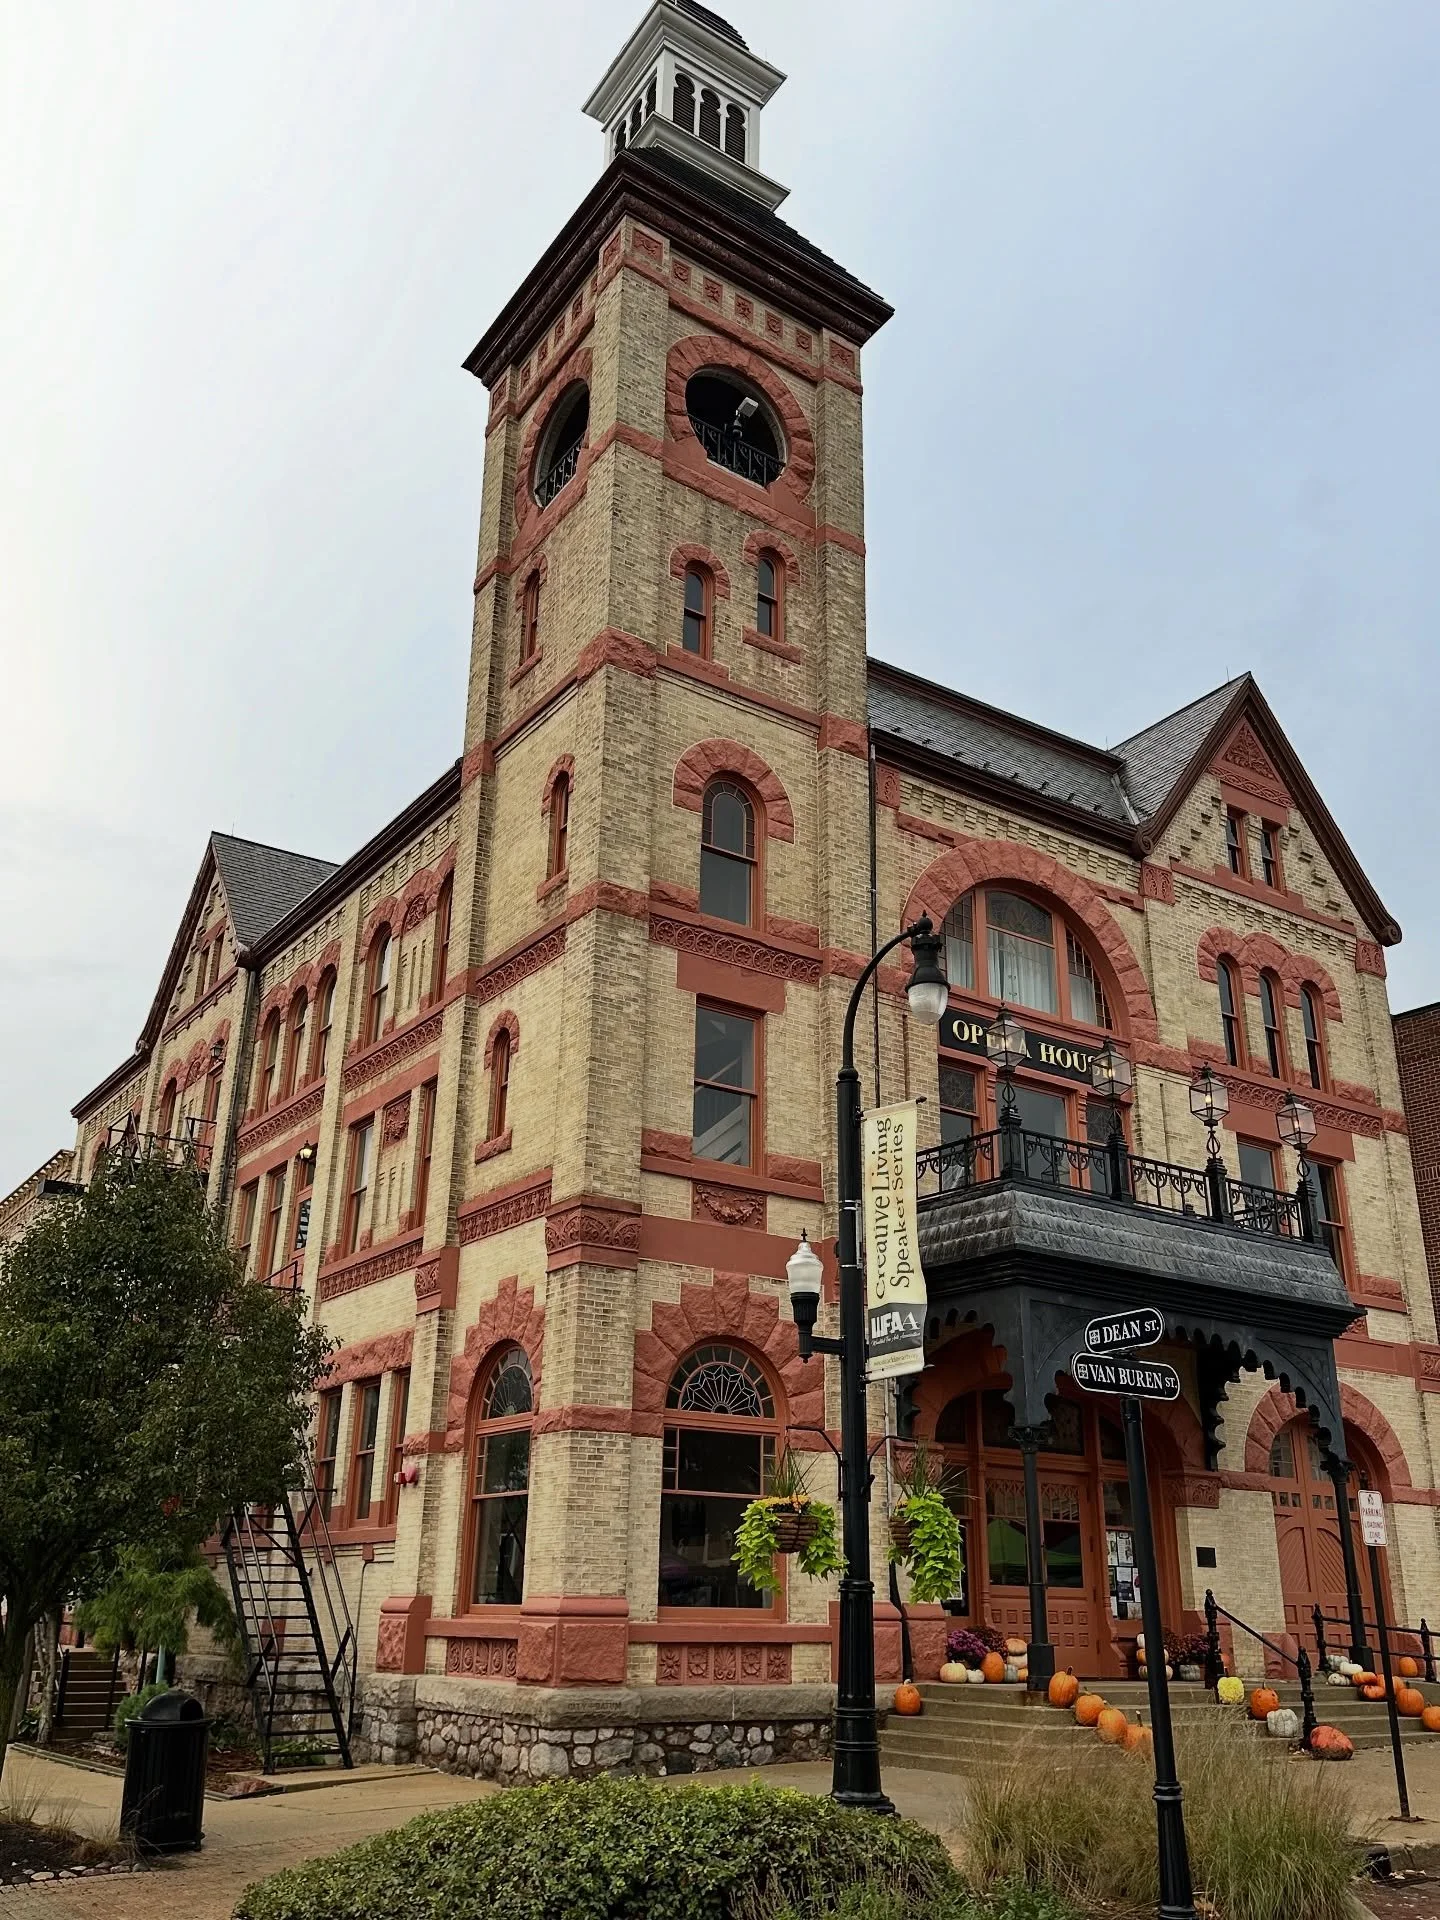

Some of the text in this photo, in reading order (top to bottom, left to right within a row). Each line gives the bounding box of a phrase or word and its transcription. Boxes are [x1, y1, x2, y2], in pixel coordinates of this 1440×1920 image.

[952, 1020, 1032, 1059] OPEA
[872, 1117, 891, 1192] Living
[890, 1123, 914, 1288] Speaker Series
[1103, 1320, 1160, 1344] DEAN ST.
[1088, 1364, 1178, 1390] VAN BUREN ST.
